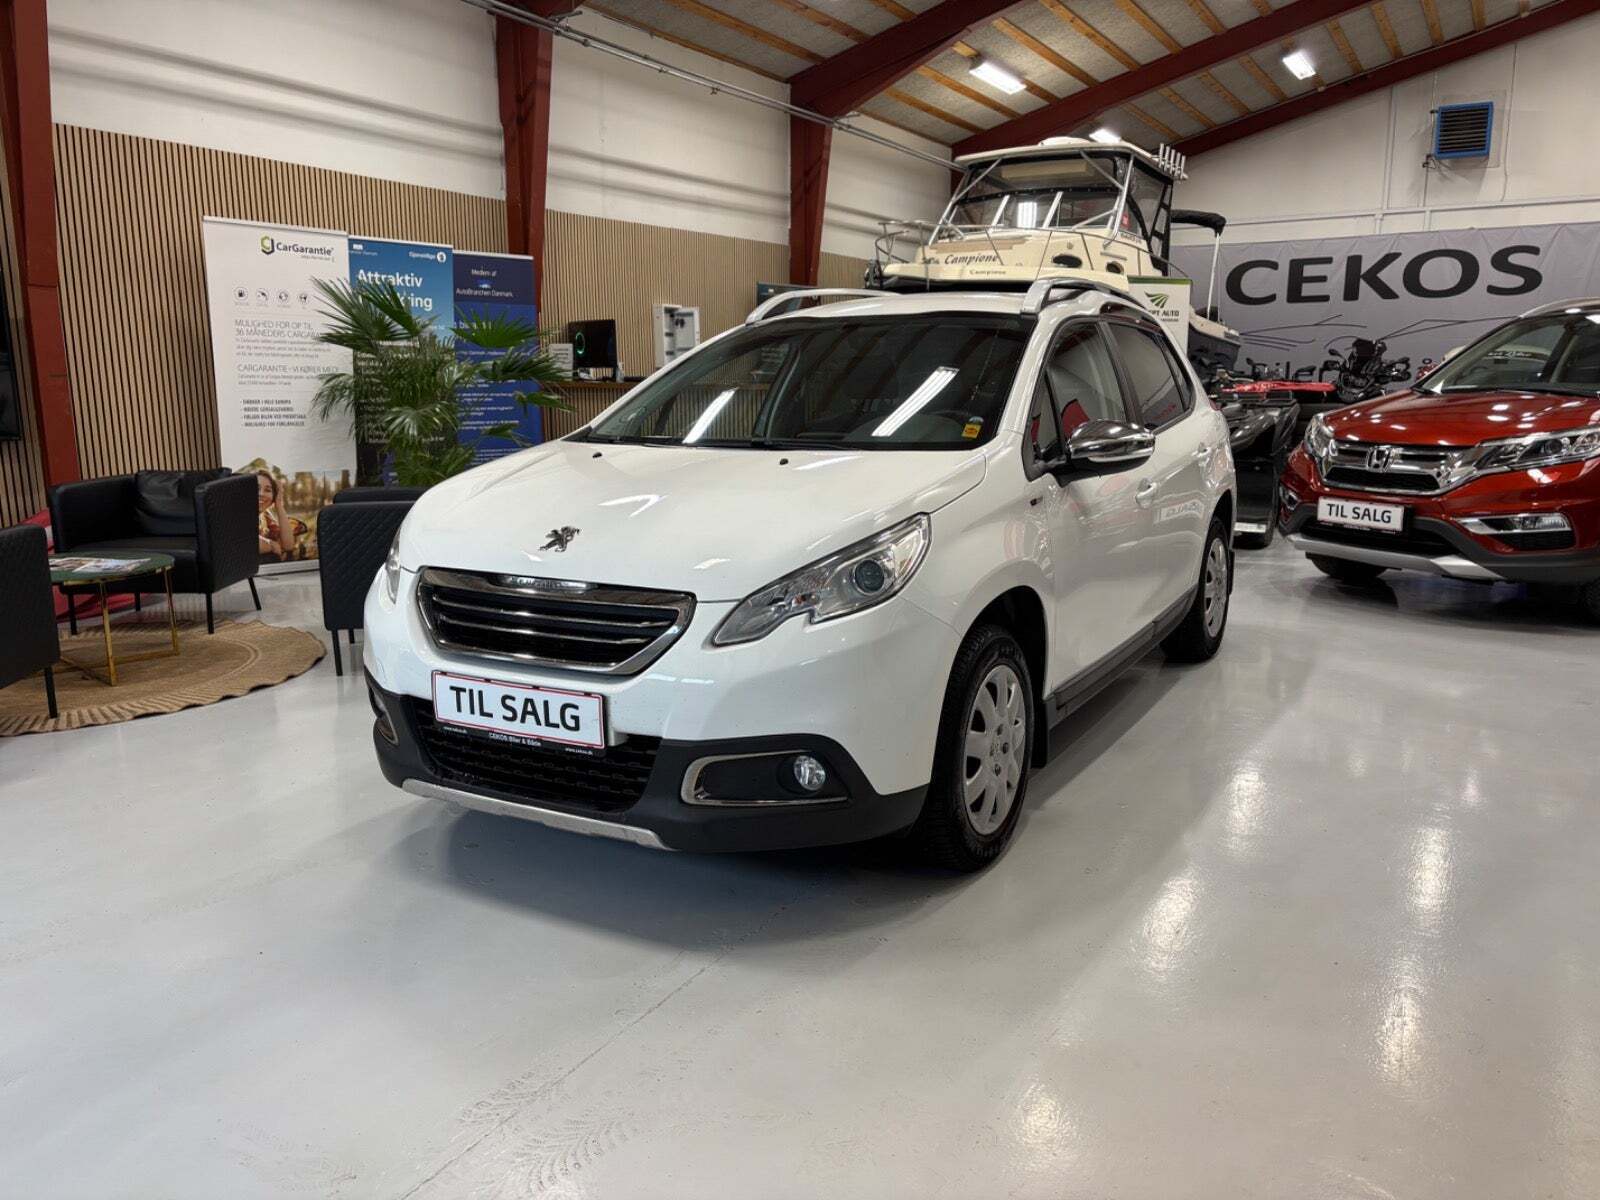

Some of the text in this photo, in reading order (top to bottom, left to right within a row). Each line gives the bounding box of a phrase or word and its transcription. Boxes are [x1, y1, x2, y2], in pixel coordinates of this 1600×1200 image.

[276, 241, 332, 256] CarGarantie
[358, 268, 423, 288] Attraktiv
[1225, 245, 1543, 305] CEKOS
[1326, 503, 1392, 524] TIL SALG
[449, 686, 580, 732] TIL SALG
